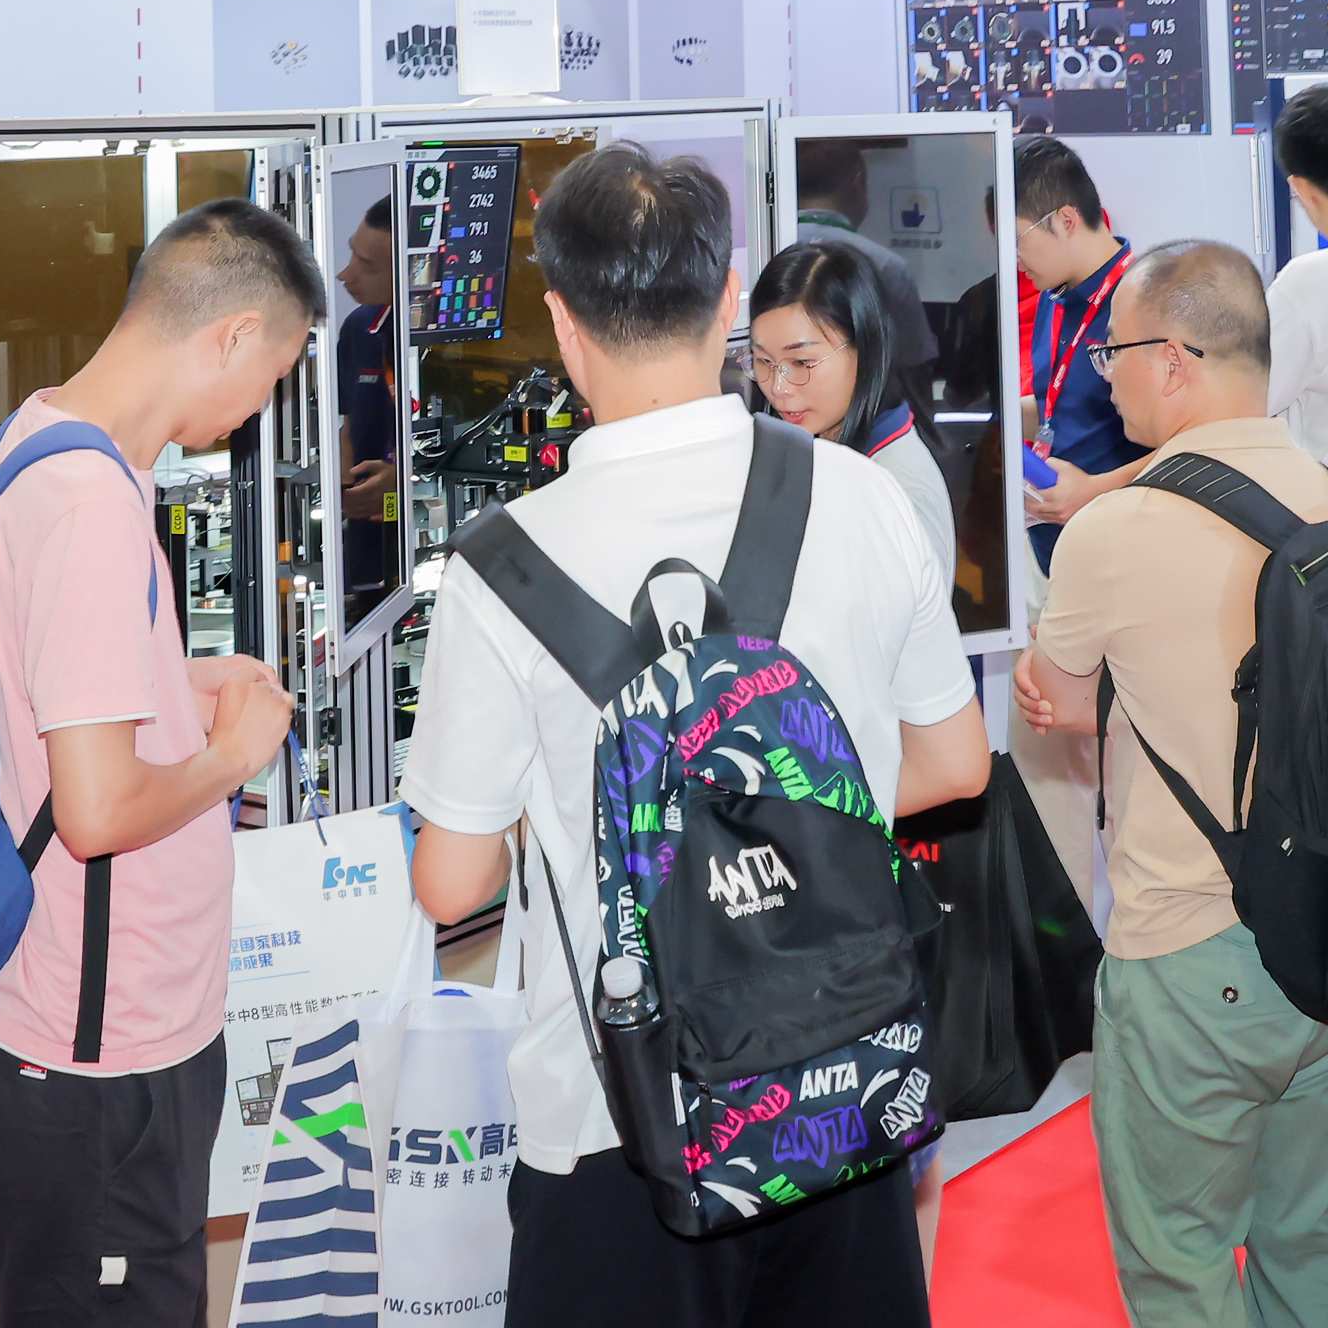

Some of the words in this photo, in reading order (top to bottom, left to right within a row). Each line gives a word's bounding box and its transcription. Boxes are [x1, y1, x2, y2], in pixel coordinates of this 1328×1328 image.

[469, 221, 489, 236] 79.1
[469, 249, 483, 264] 36
[708, 843, 798, 905] ANTA
[799, 1061, 859, 1102] ANTA
